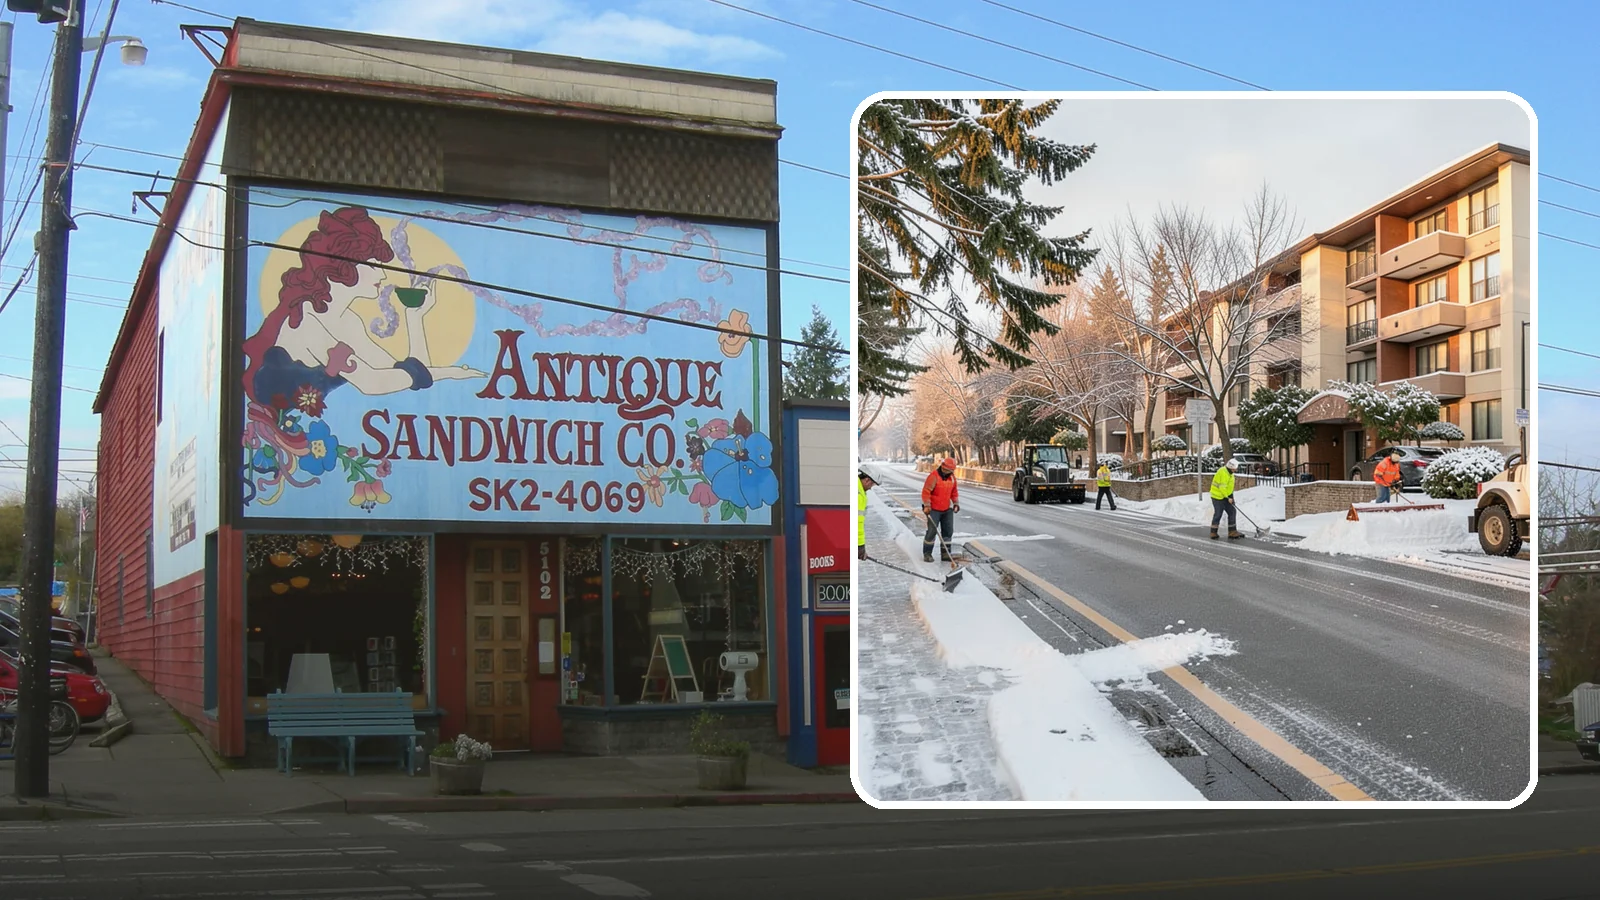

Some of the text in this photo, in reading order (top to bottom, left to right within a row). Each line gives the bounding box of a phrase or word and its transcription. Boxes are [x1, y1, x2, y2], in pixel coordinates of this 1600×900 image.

[474, 328, 724, 421] ANTIQUE
[361, 408, 685, 469] SANDWICH CO.
[468, 477, 646, 513] SK2-4069
[540, 541, 552, 600] 5102
[809, 554, 835, 569] BOOKS
